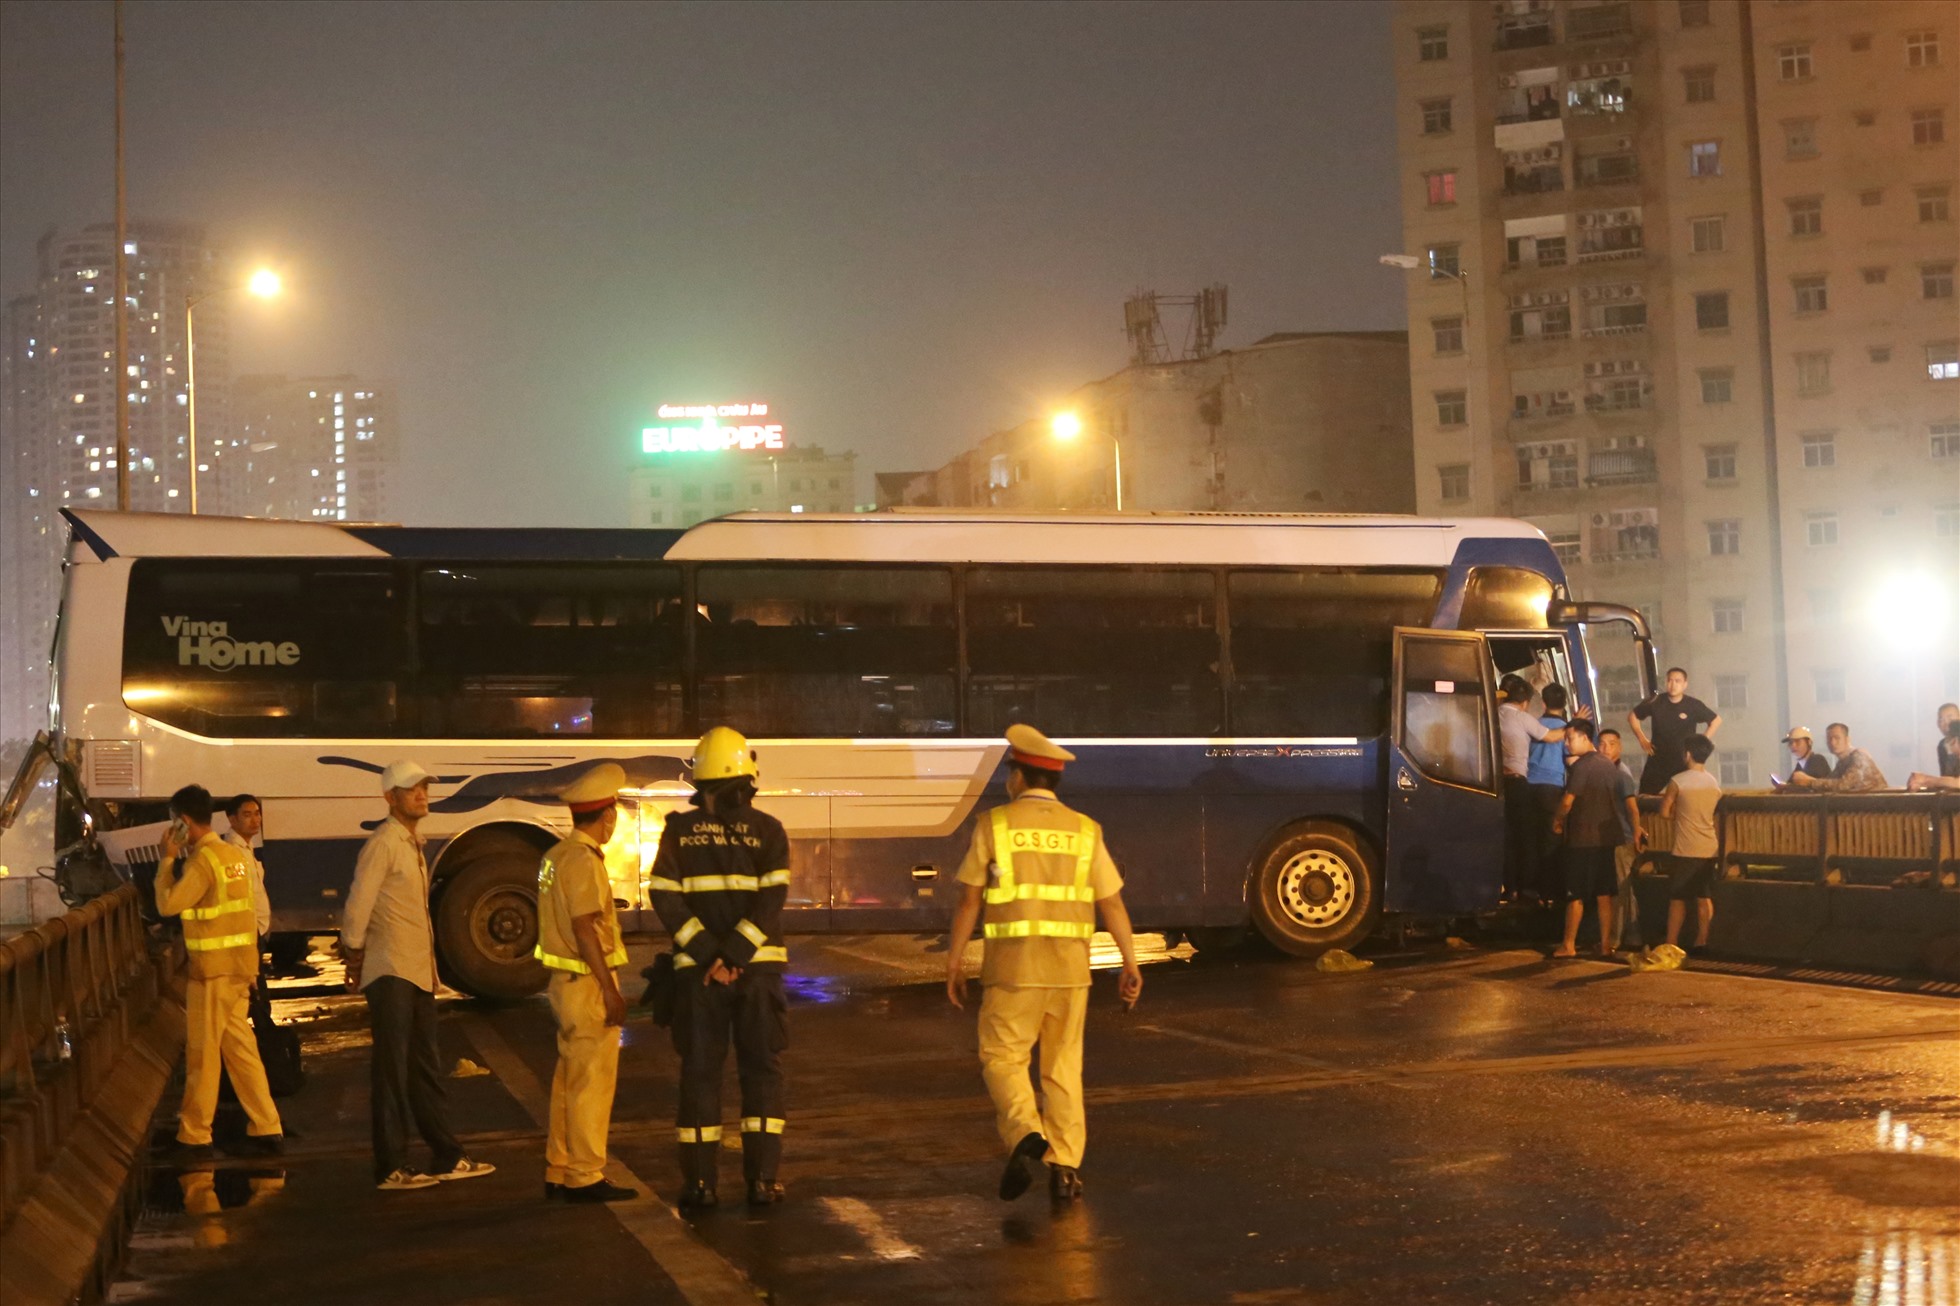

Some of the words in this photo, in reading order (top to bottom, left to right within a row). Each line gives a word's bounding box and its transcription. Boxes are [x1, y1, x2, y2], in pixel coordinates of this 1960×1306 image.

[160, 615, 228, 637] Vina
[178, 636, 300, 670] Home
[679, 834, 710, 847] PCCC
[1013, 832, 1075, 850] C.S.G.T
